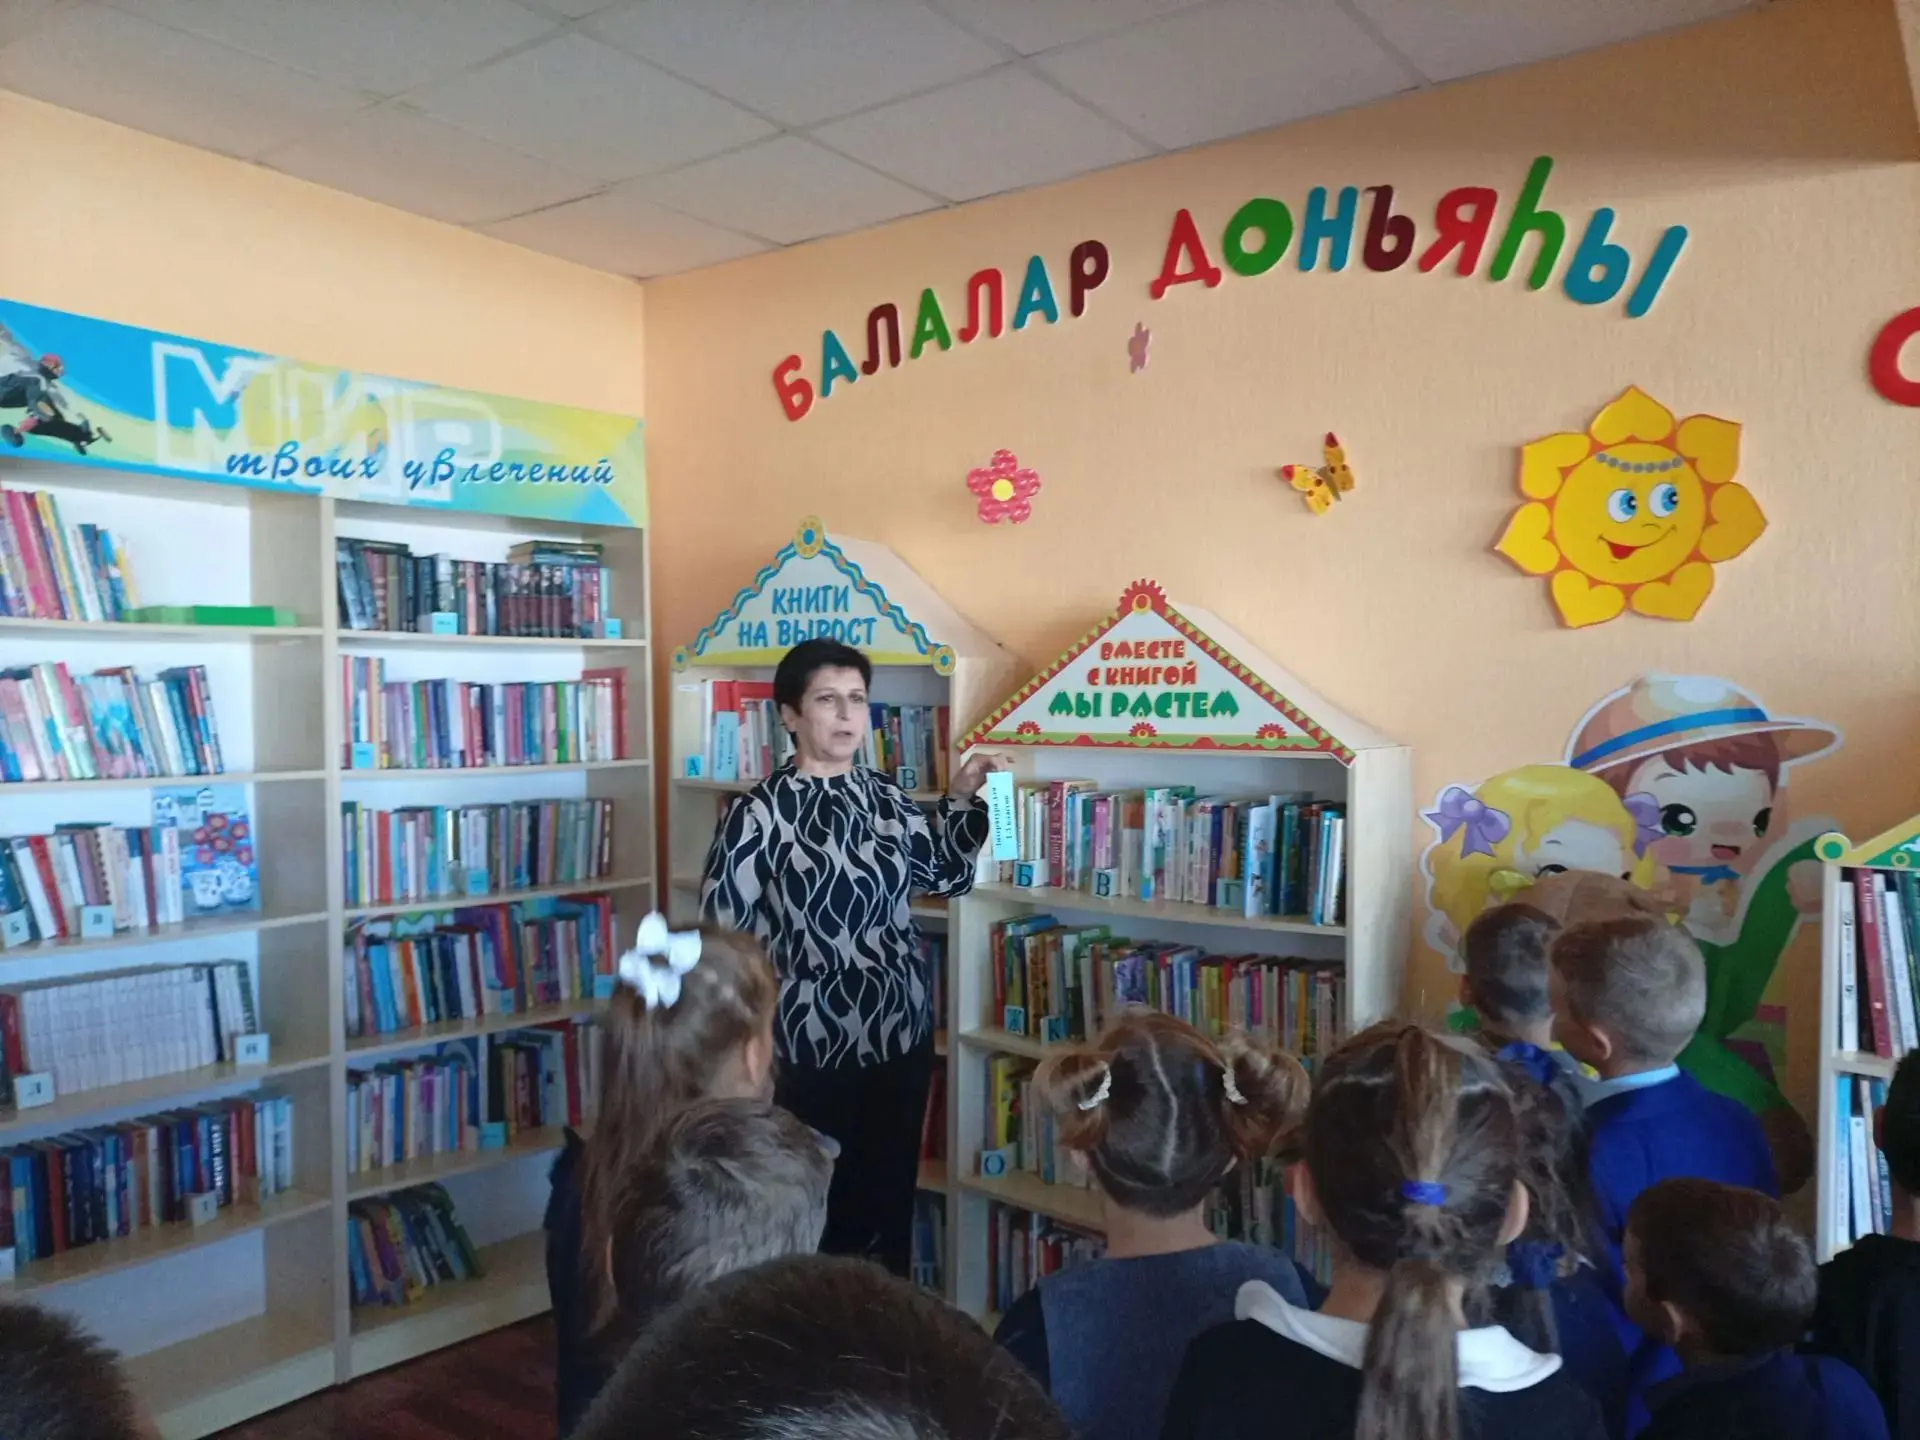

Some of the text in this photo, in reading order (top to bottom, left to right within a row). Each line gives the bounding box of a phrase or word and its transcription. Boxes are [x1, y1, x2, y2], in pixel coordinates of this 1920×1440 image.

[771, 239, 1109, 422] БАЛАЛАР
[151, 341, 503, 501] МИР
[226, 440, 615, 491] твоих увлечений
[771, 584, 850, 615] КНИГИ
[738, 617, 878, 648] НА ВЫРОСТ
[1100, 640, 1185, 660] ВМЕСТЕ
[1087, 660, 1197, 687] С КНИГОЙ
[1048, 689, 1240, 719] МЫ РАСТЕМ
[686, 757, 701, 777] А
[901, 768, 917, 790] В
[1018, 863, 1033, 887] Б
[1096, 871, 1111, 897] В
